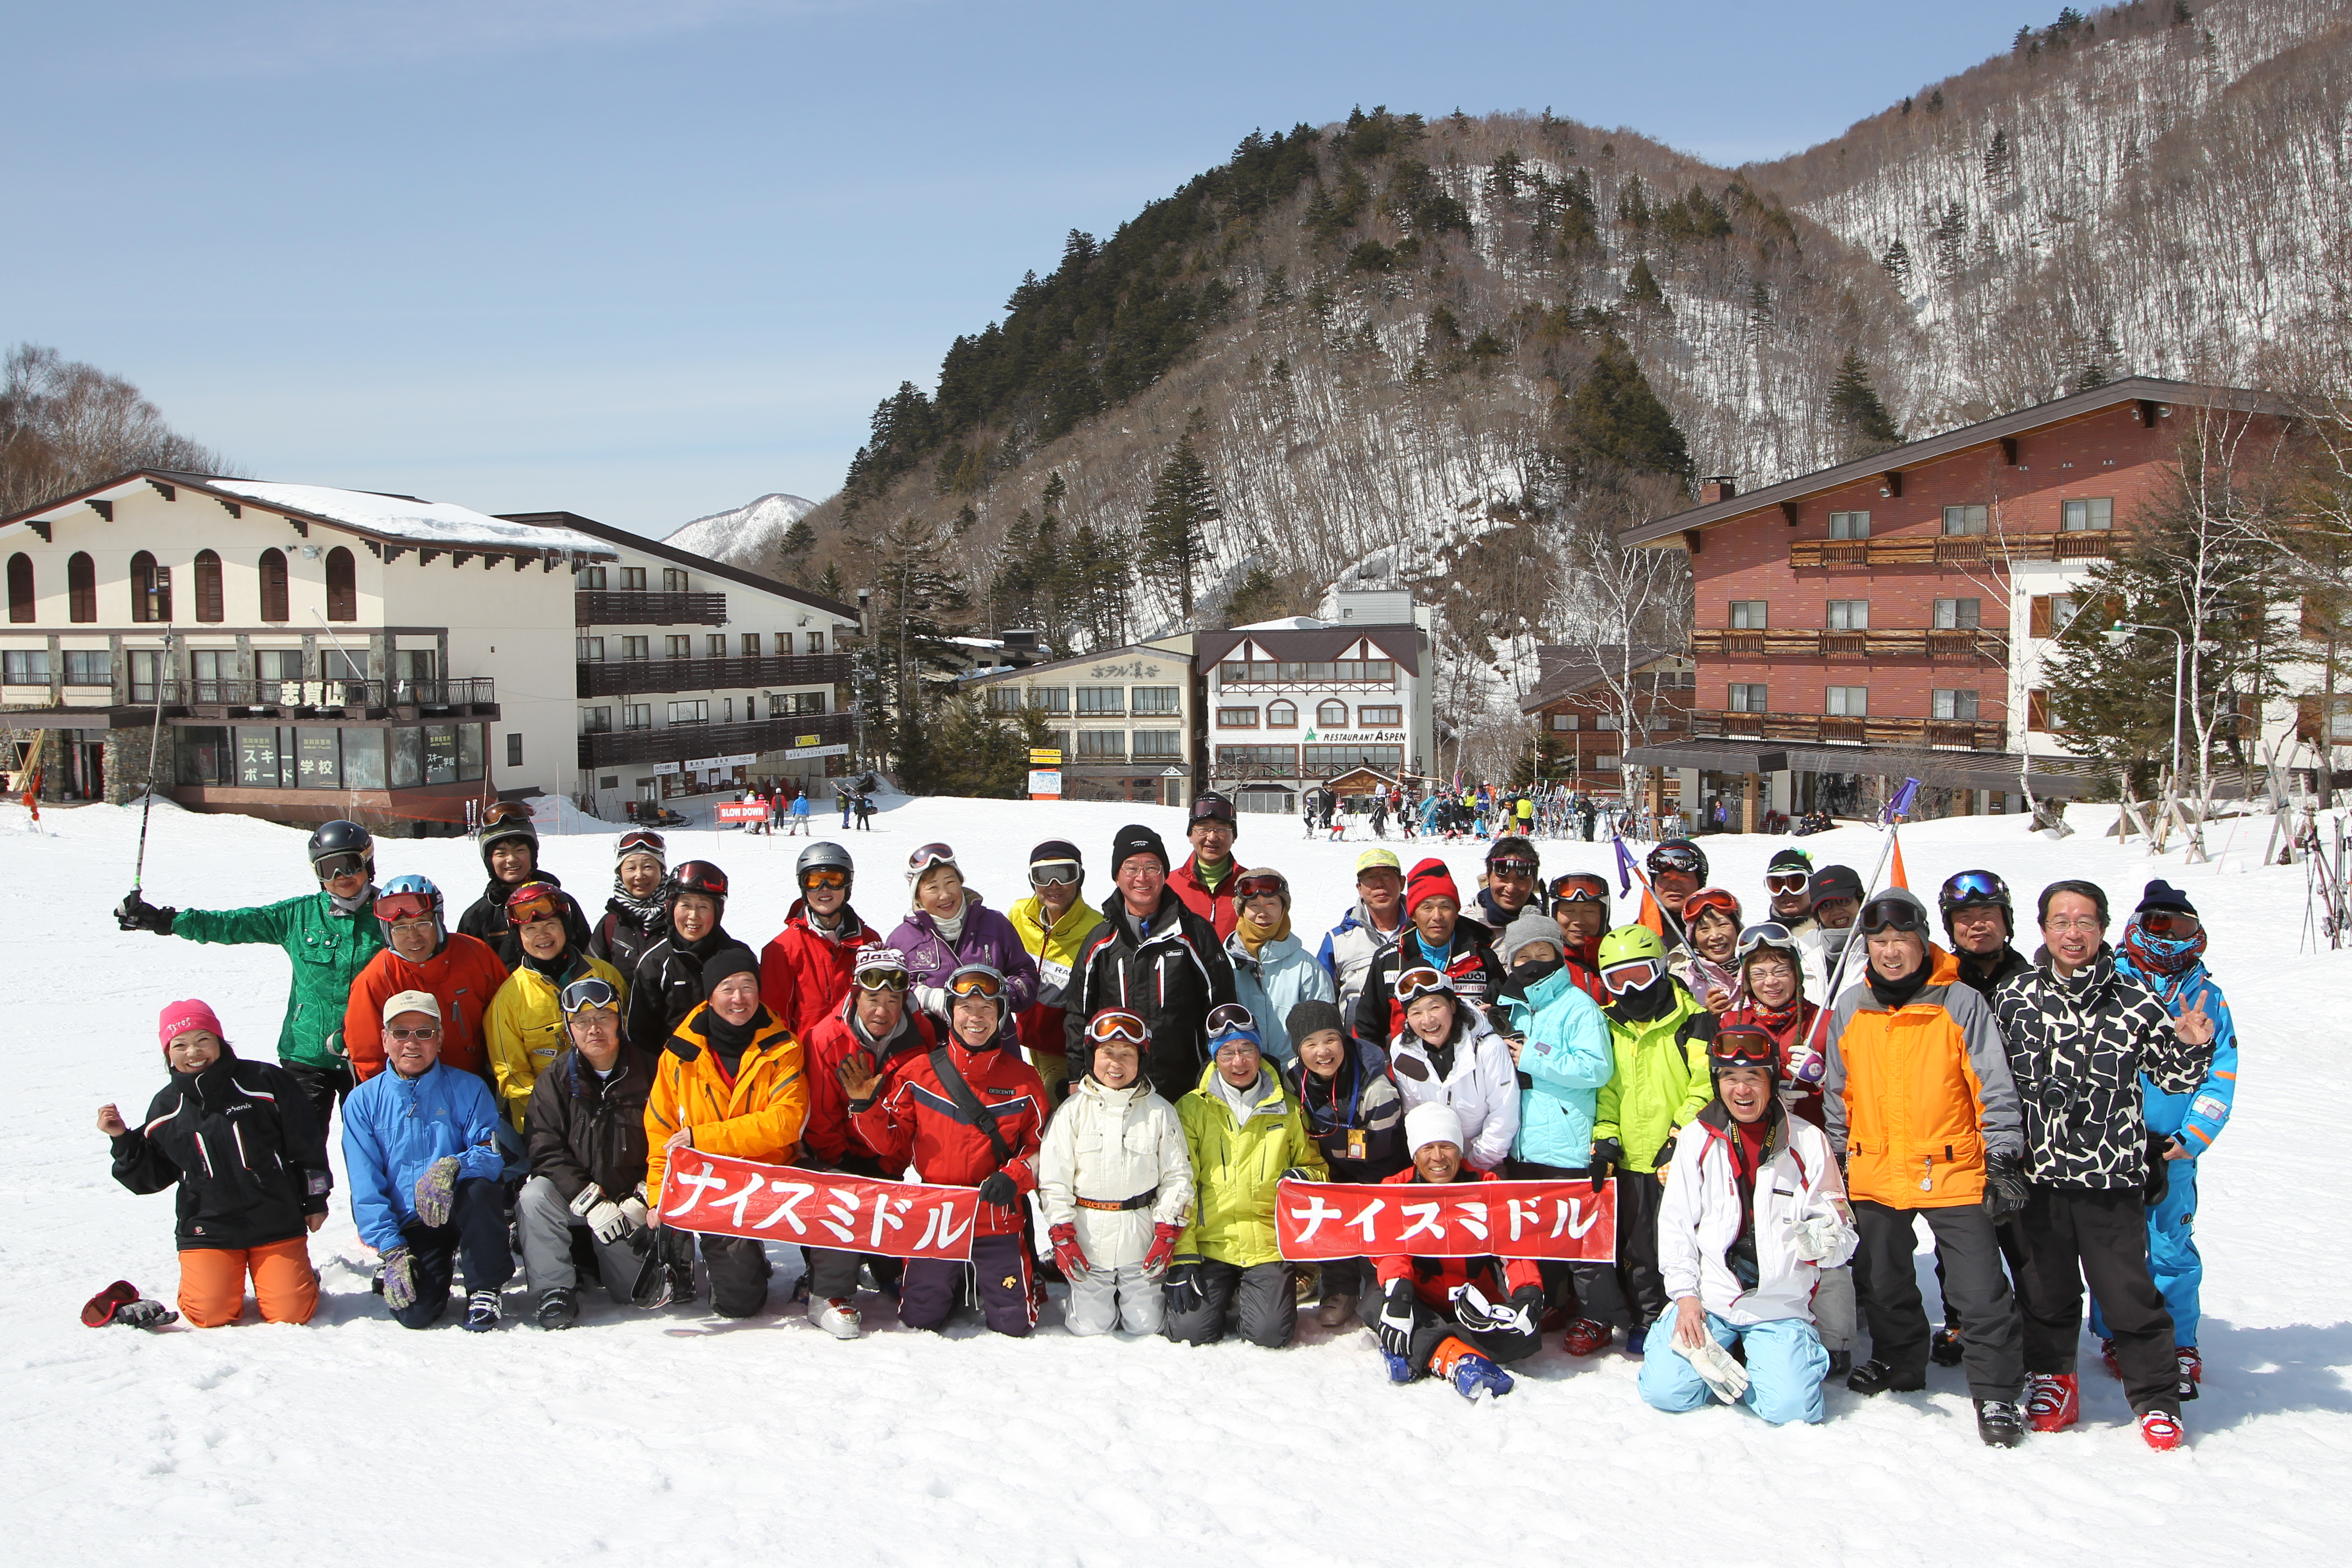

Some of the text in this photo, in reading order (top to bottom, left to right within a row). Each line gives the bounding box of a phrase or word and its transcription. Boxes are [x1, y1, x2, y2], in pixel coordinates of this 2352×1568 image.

[280, 681, 346, 707] 志賀山
[244, 749, 293, 764] スキー
[428, 753, 443, 762] スキー
[443, 757, 455, 767] 学校
[300, 760, 333, 775] 学校
[428, 764, 443, 773] ボード
[244, 768, 293, 783] ボード
[721, 807, 764, 817] SLOW DOWN
[226, 1102, 252, 1115] phenix
[1765, 1126, 1776, 1147] Nikon
[665, 1162, 971, 1250] ナイスミドル
[1290, 1195, 1598, 1243] ナイスミドル
